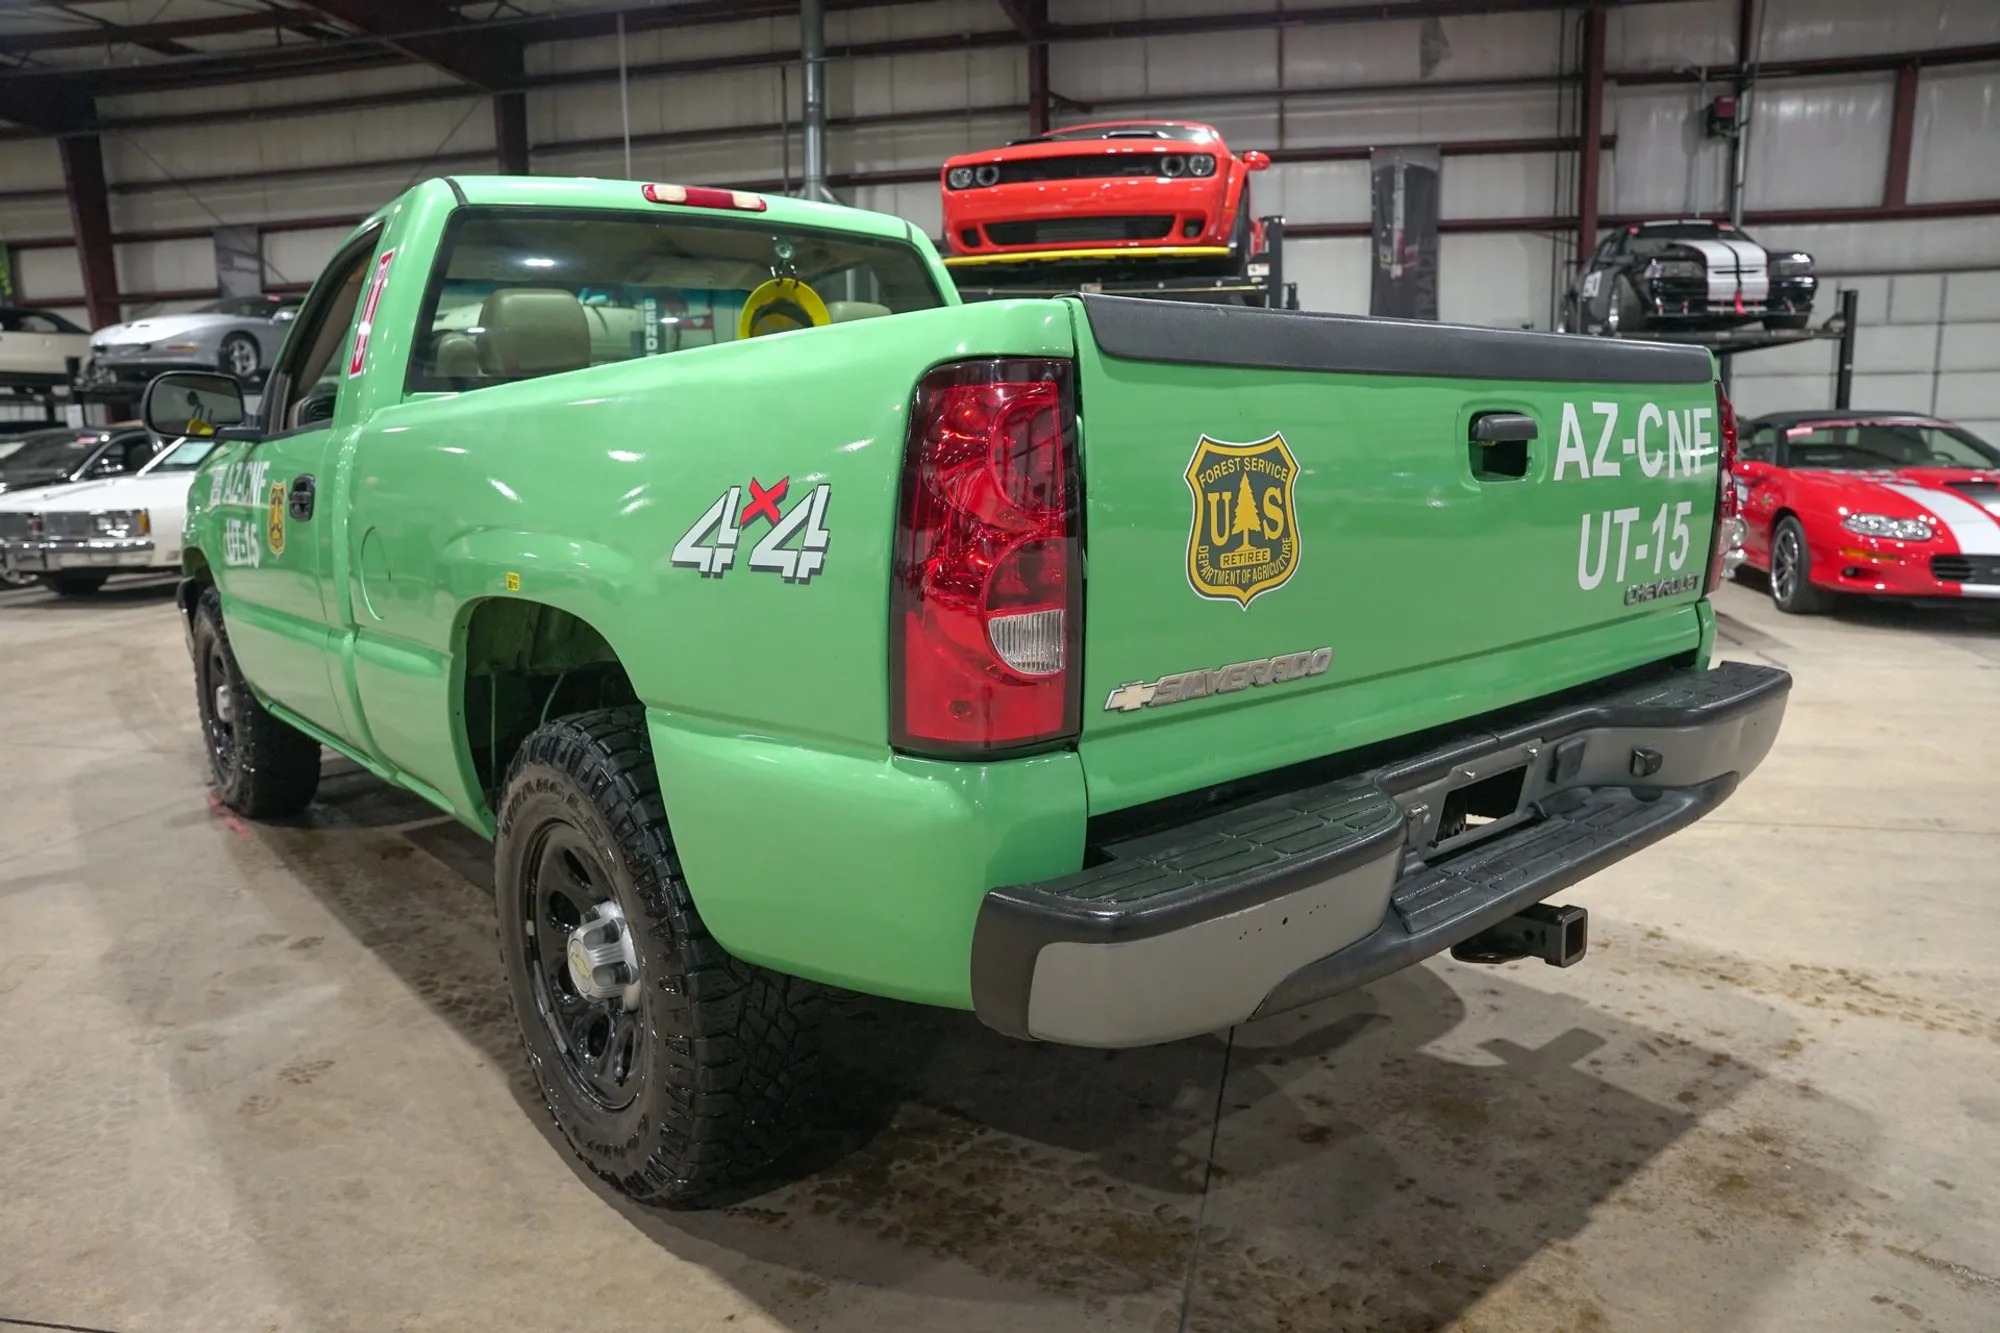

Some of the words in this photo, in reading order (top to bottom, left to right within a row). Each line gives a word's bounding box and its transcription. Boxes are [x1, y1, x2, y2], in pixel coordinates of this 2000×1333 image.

[644, 299, 658, 357] BEND
[1553, 401, 1712, 481] AZ-CNF
[1199, 457, 1241, 488] FOREST
[1243, 457, 1289, 483] SERVICE
[1207, 491, 1232, 547] U
[1263, 486, 1285, 541] S
[1198, 545, 1241, 586] DEPARTMENT
[1242, 569, 1252, 584] OF
[1252, 536, 1293, 584] AGRICULTURE
[1222, 553, 1268, 568] RETIREE
[1578, 501, 1692, 591] UT-15
[1149, 648, 1333, 707] SILVERADO
